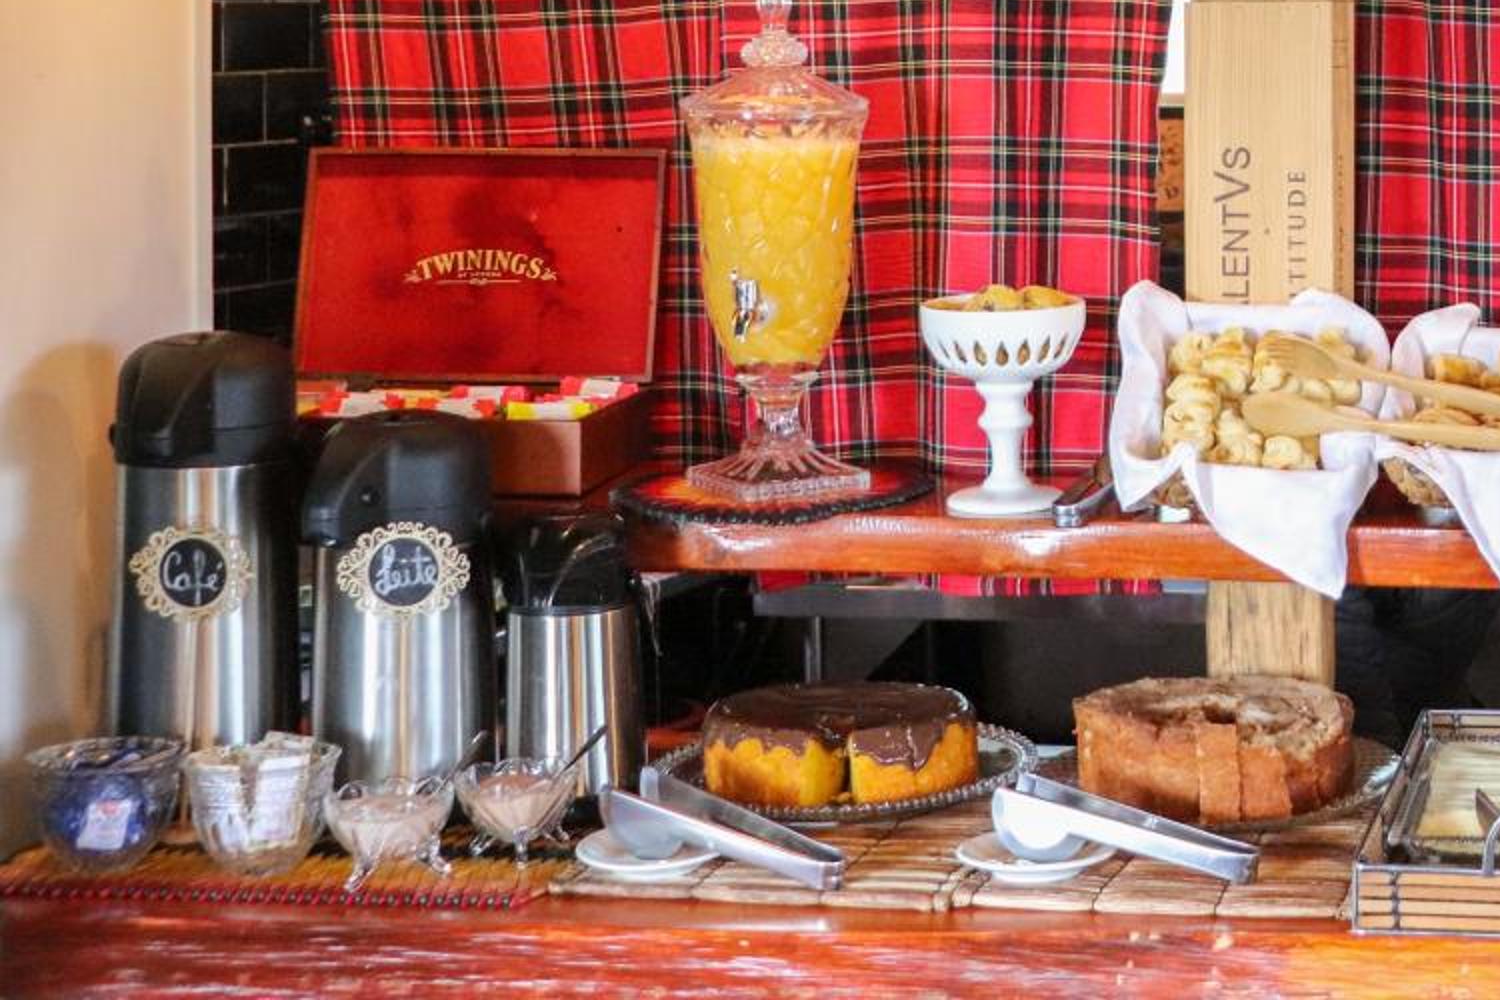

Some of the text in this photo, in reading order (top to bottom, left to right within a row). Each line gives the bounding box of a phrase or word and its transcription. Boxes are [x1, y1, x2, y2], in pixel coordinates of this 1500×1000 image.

[1213, 147, 1251, 304] LENTVS
[1287, 171, 1307, 298] TITUDE
[416, 249, 545, 281] TWININGS
[161, 549, 225, 605] Café
[374, 543, 438, 596] Leite
